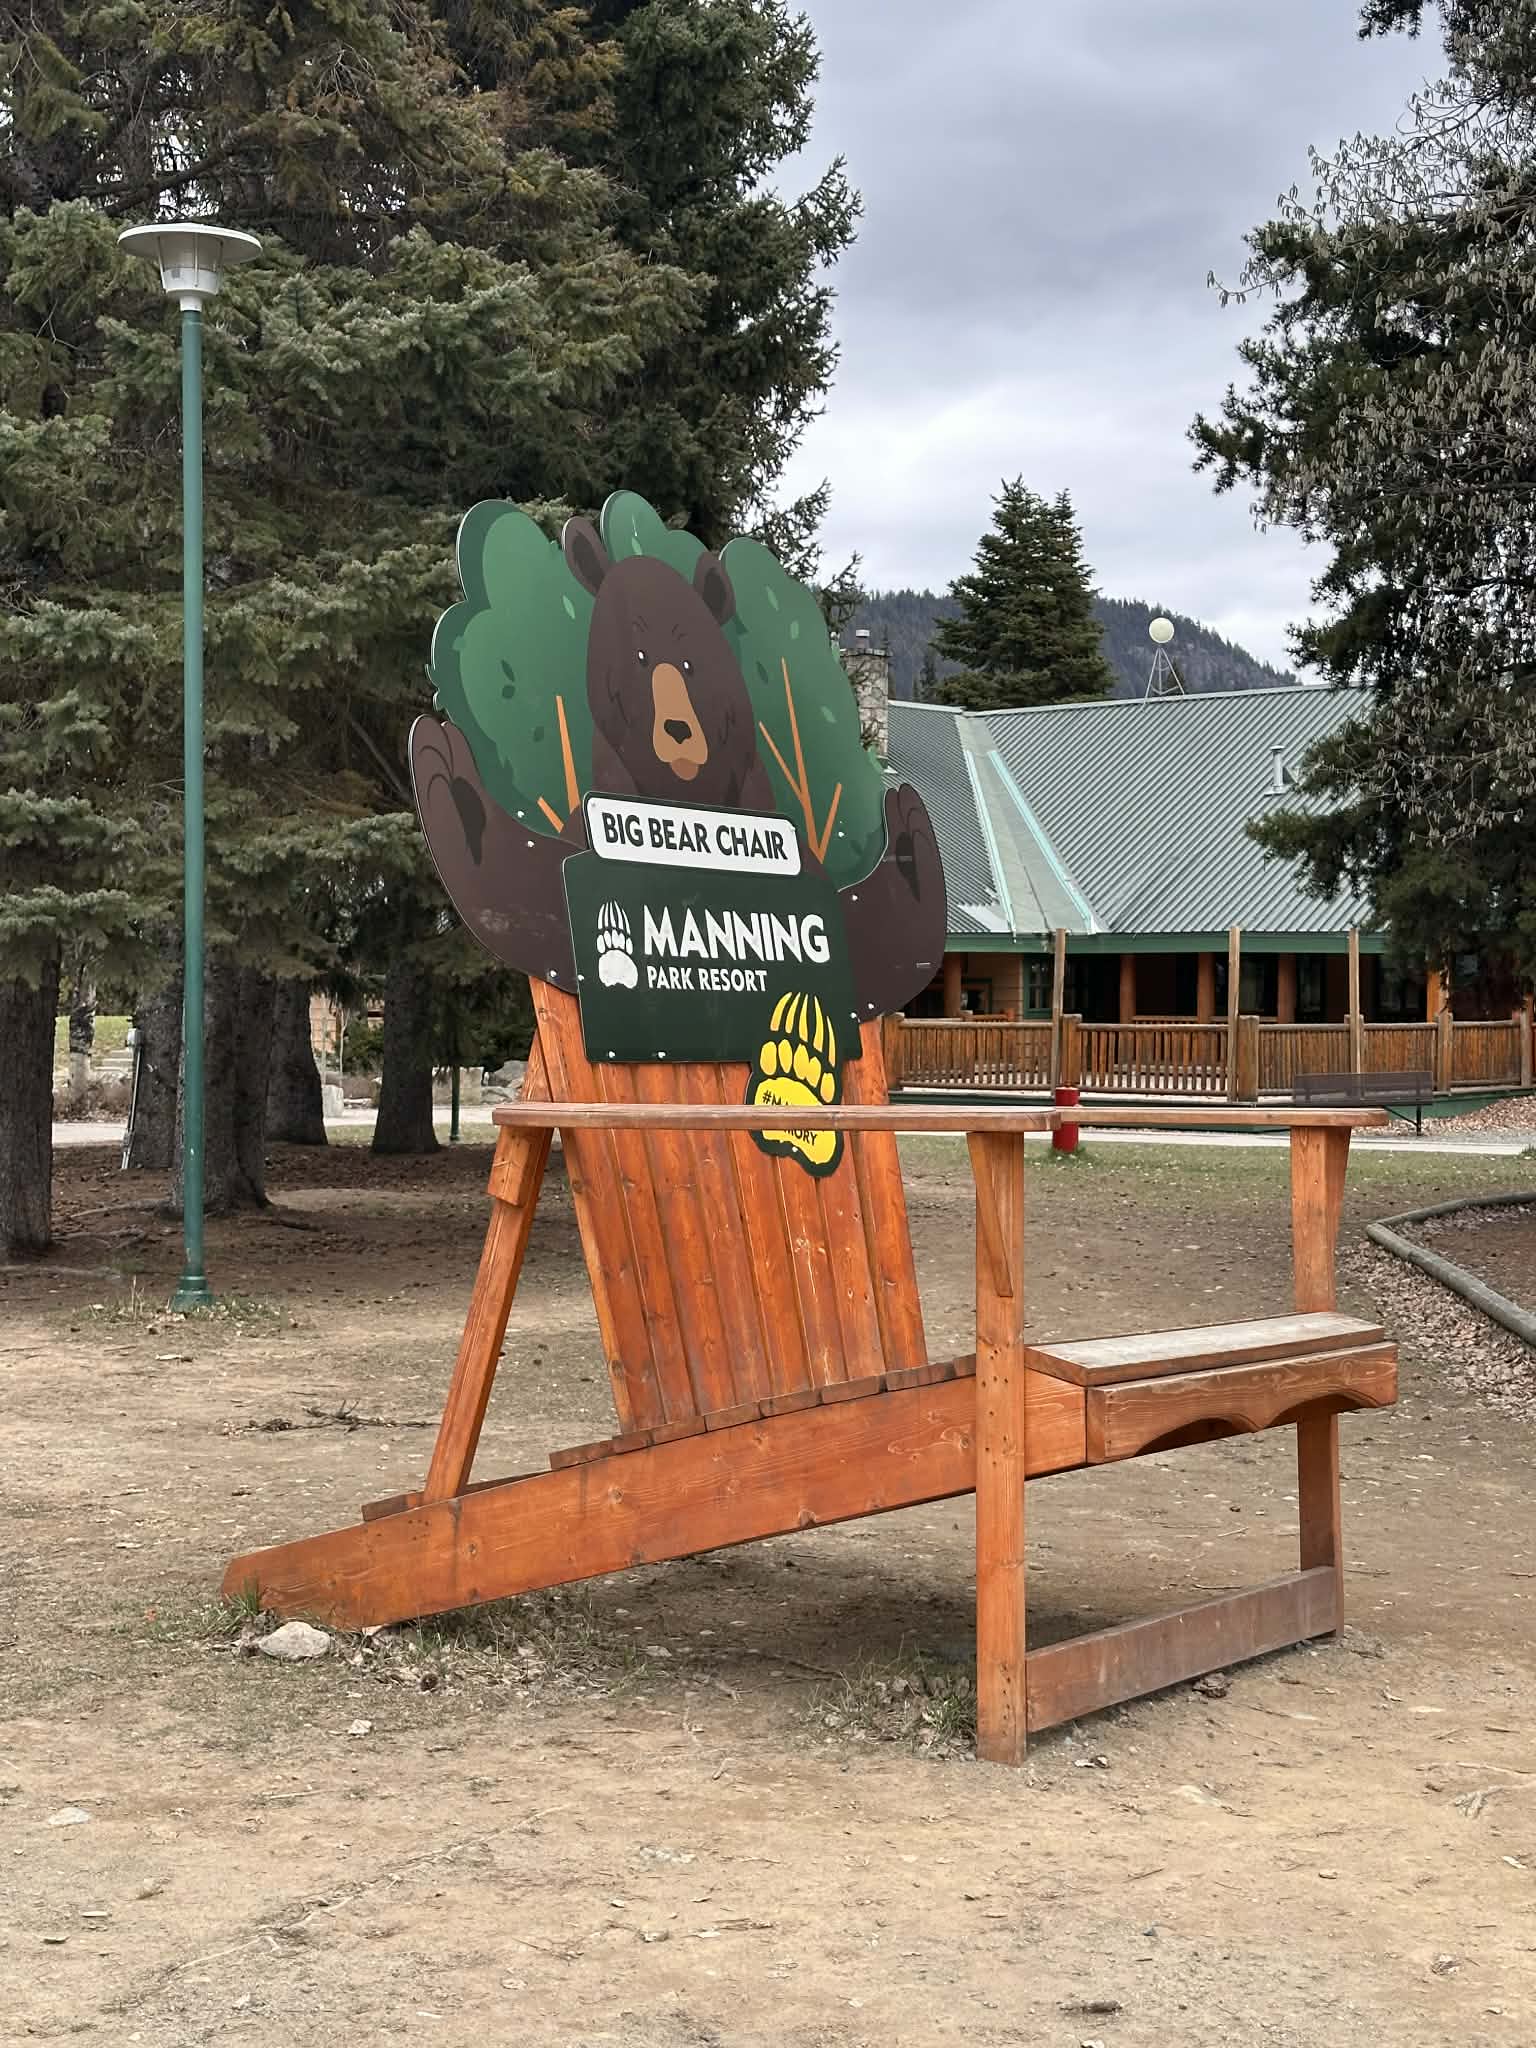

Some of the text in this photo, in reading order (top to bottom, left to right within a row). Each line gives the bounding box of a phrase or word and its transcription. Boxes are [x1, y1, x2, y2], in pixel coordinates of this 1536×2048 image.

[601, 812, 788, 860] BIG BEAR CHAIR
[643, 904, 831, 963] MANNING
[646, 965, 768, 992] PARK RESORT
